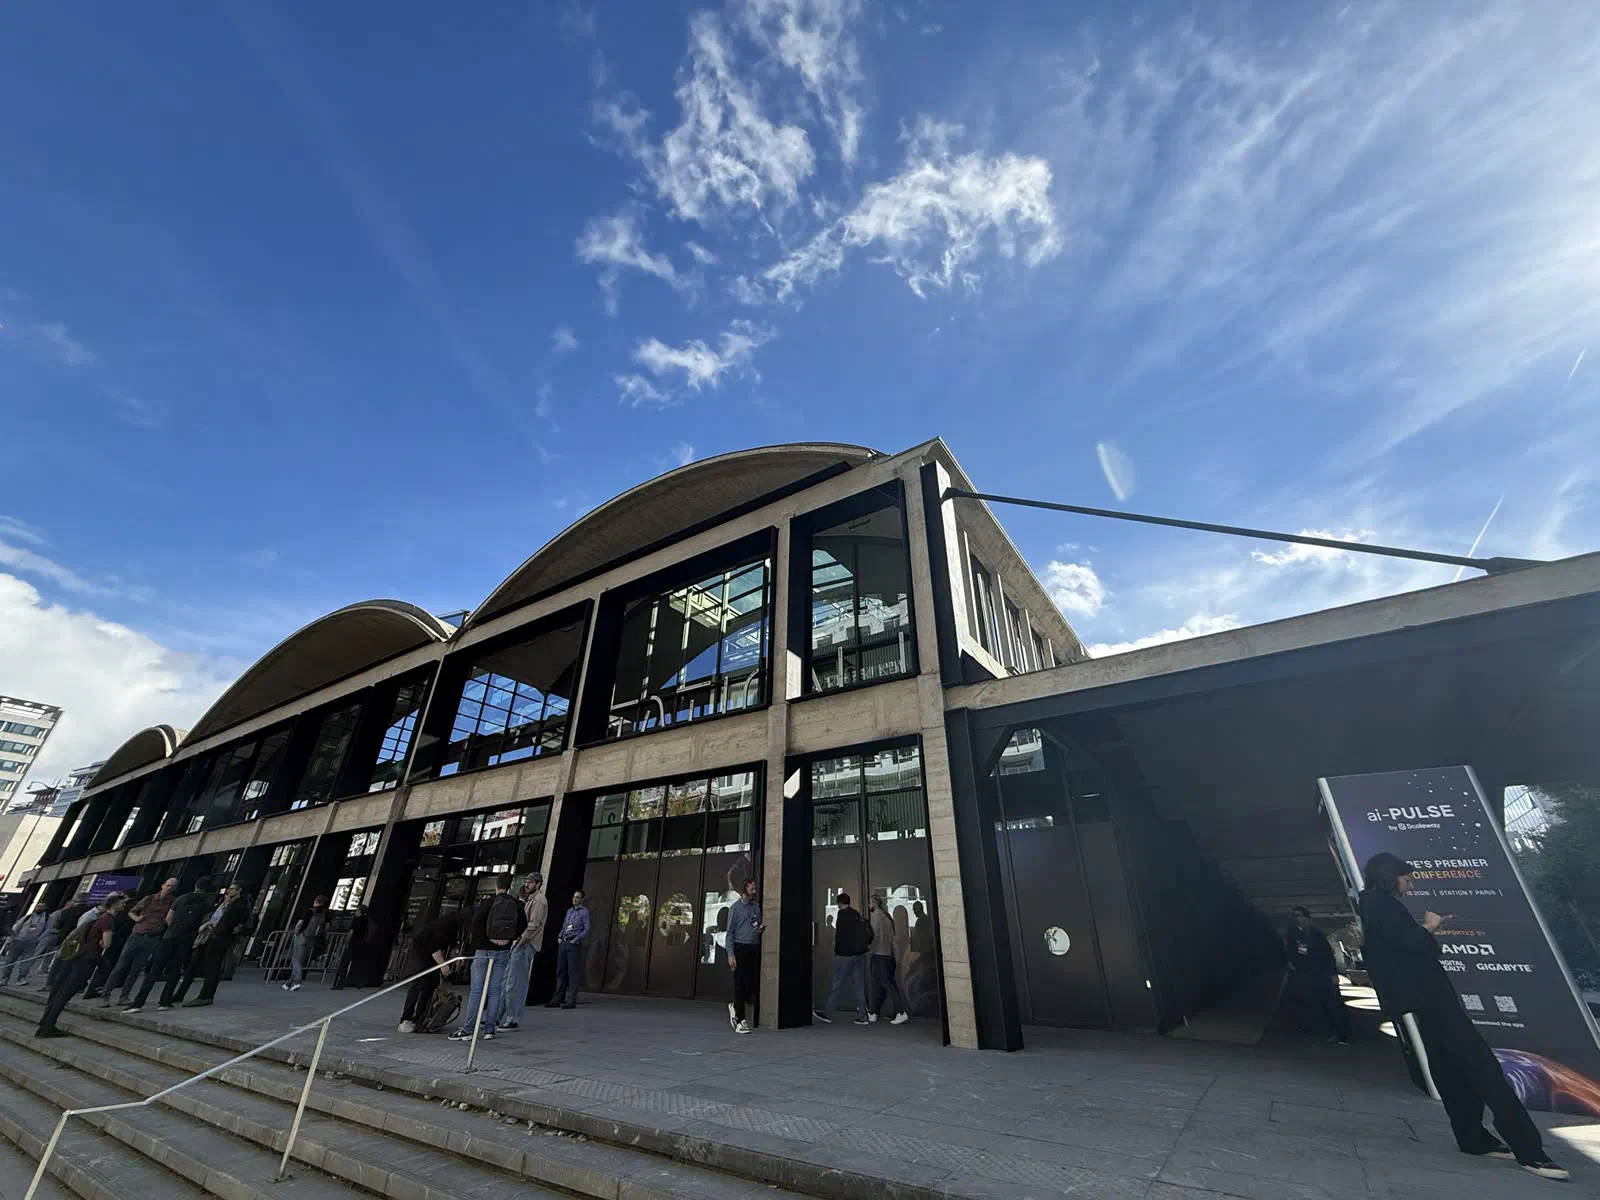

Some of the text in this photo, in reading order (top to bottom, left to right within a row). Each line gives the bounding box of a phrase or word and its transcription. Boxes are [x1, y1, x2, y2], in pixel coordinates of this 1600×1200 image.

[1366, 804, 1455, 822] ai-PULSE
[1434, 858, 1489, 868] PREMIER
[1412, 869, 1483, 880] ONFERENCE
[1441, 943, 1480, 955] AMD
[1476, 962, 1533, 972] GIGABYTE
